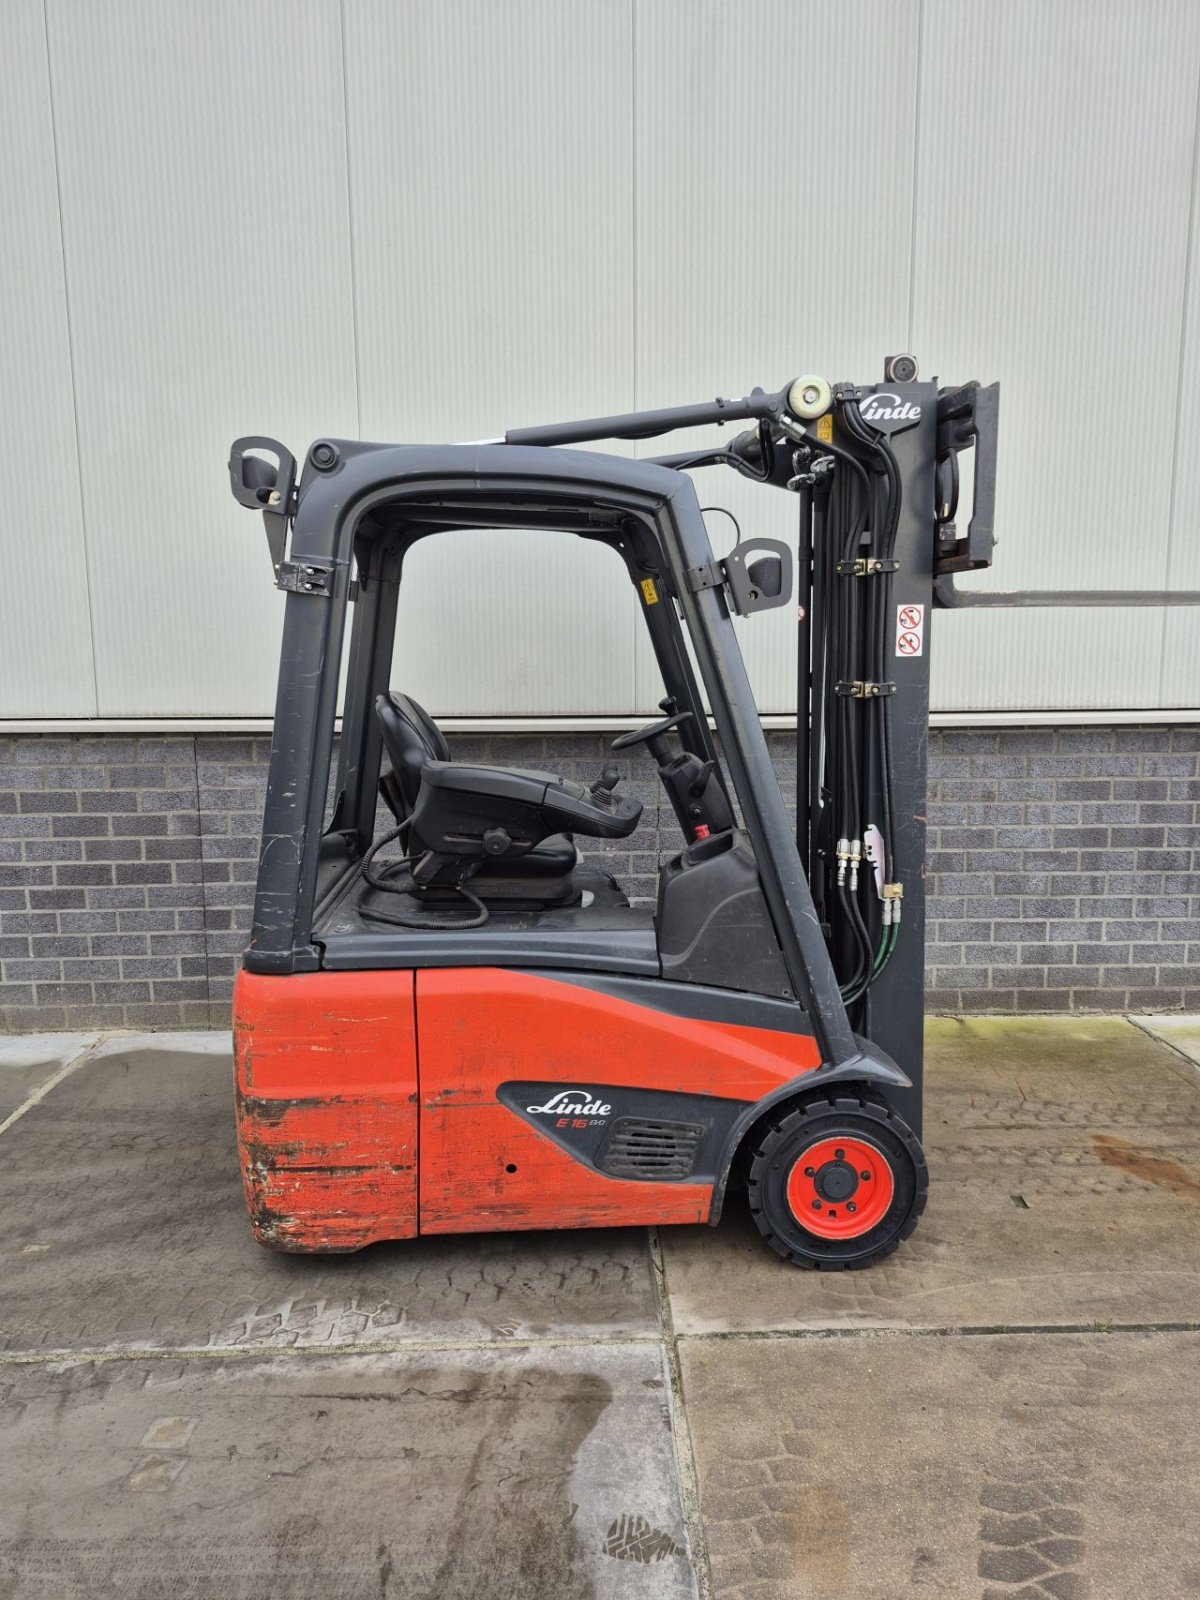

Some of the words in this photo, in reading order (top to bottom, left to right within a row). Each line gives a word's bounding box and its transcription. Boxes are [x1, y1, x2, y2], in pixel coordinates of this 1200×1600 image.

[526, 1090, 611, 1116] Linde
[555, 1118, 569, 1128] E
[571, 1118, 588, 1129] 16
